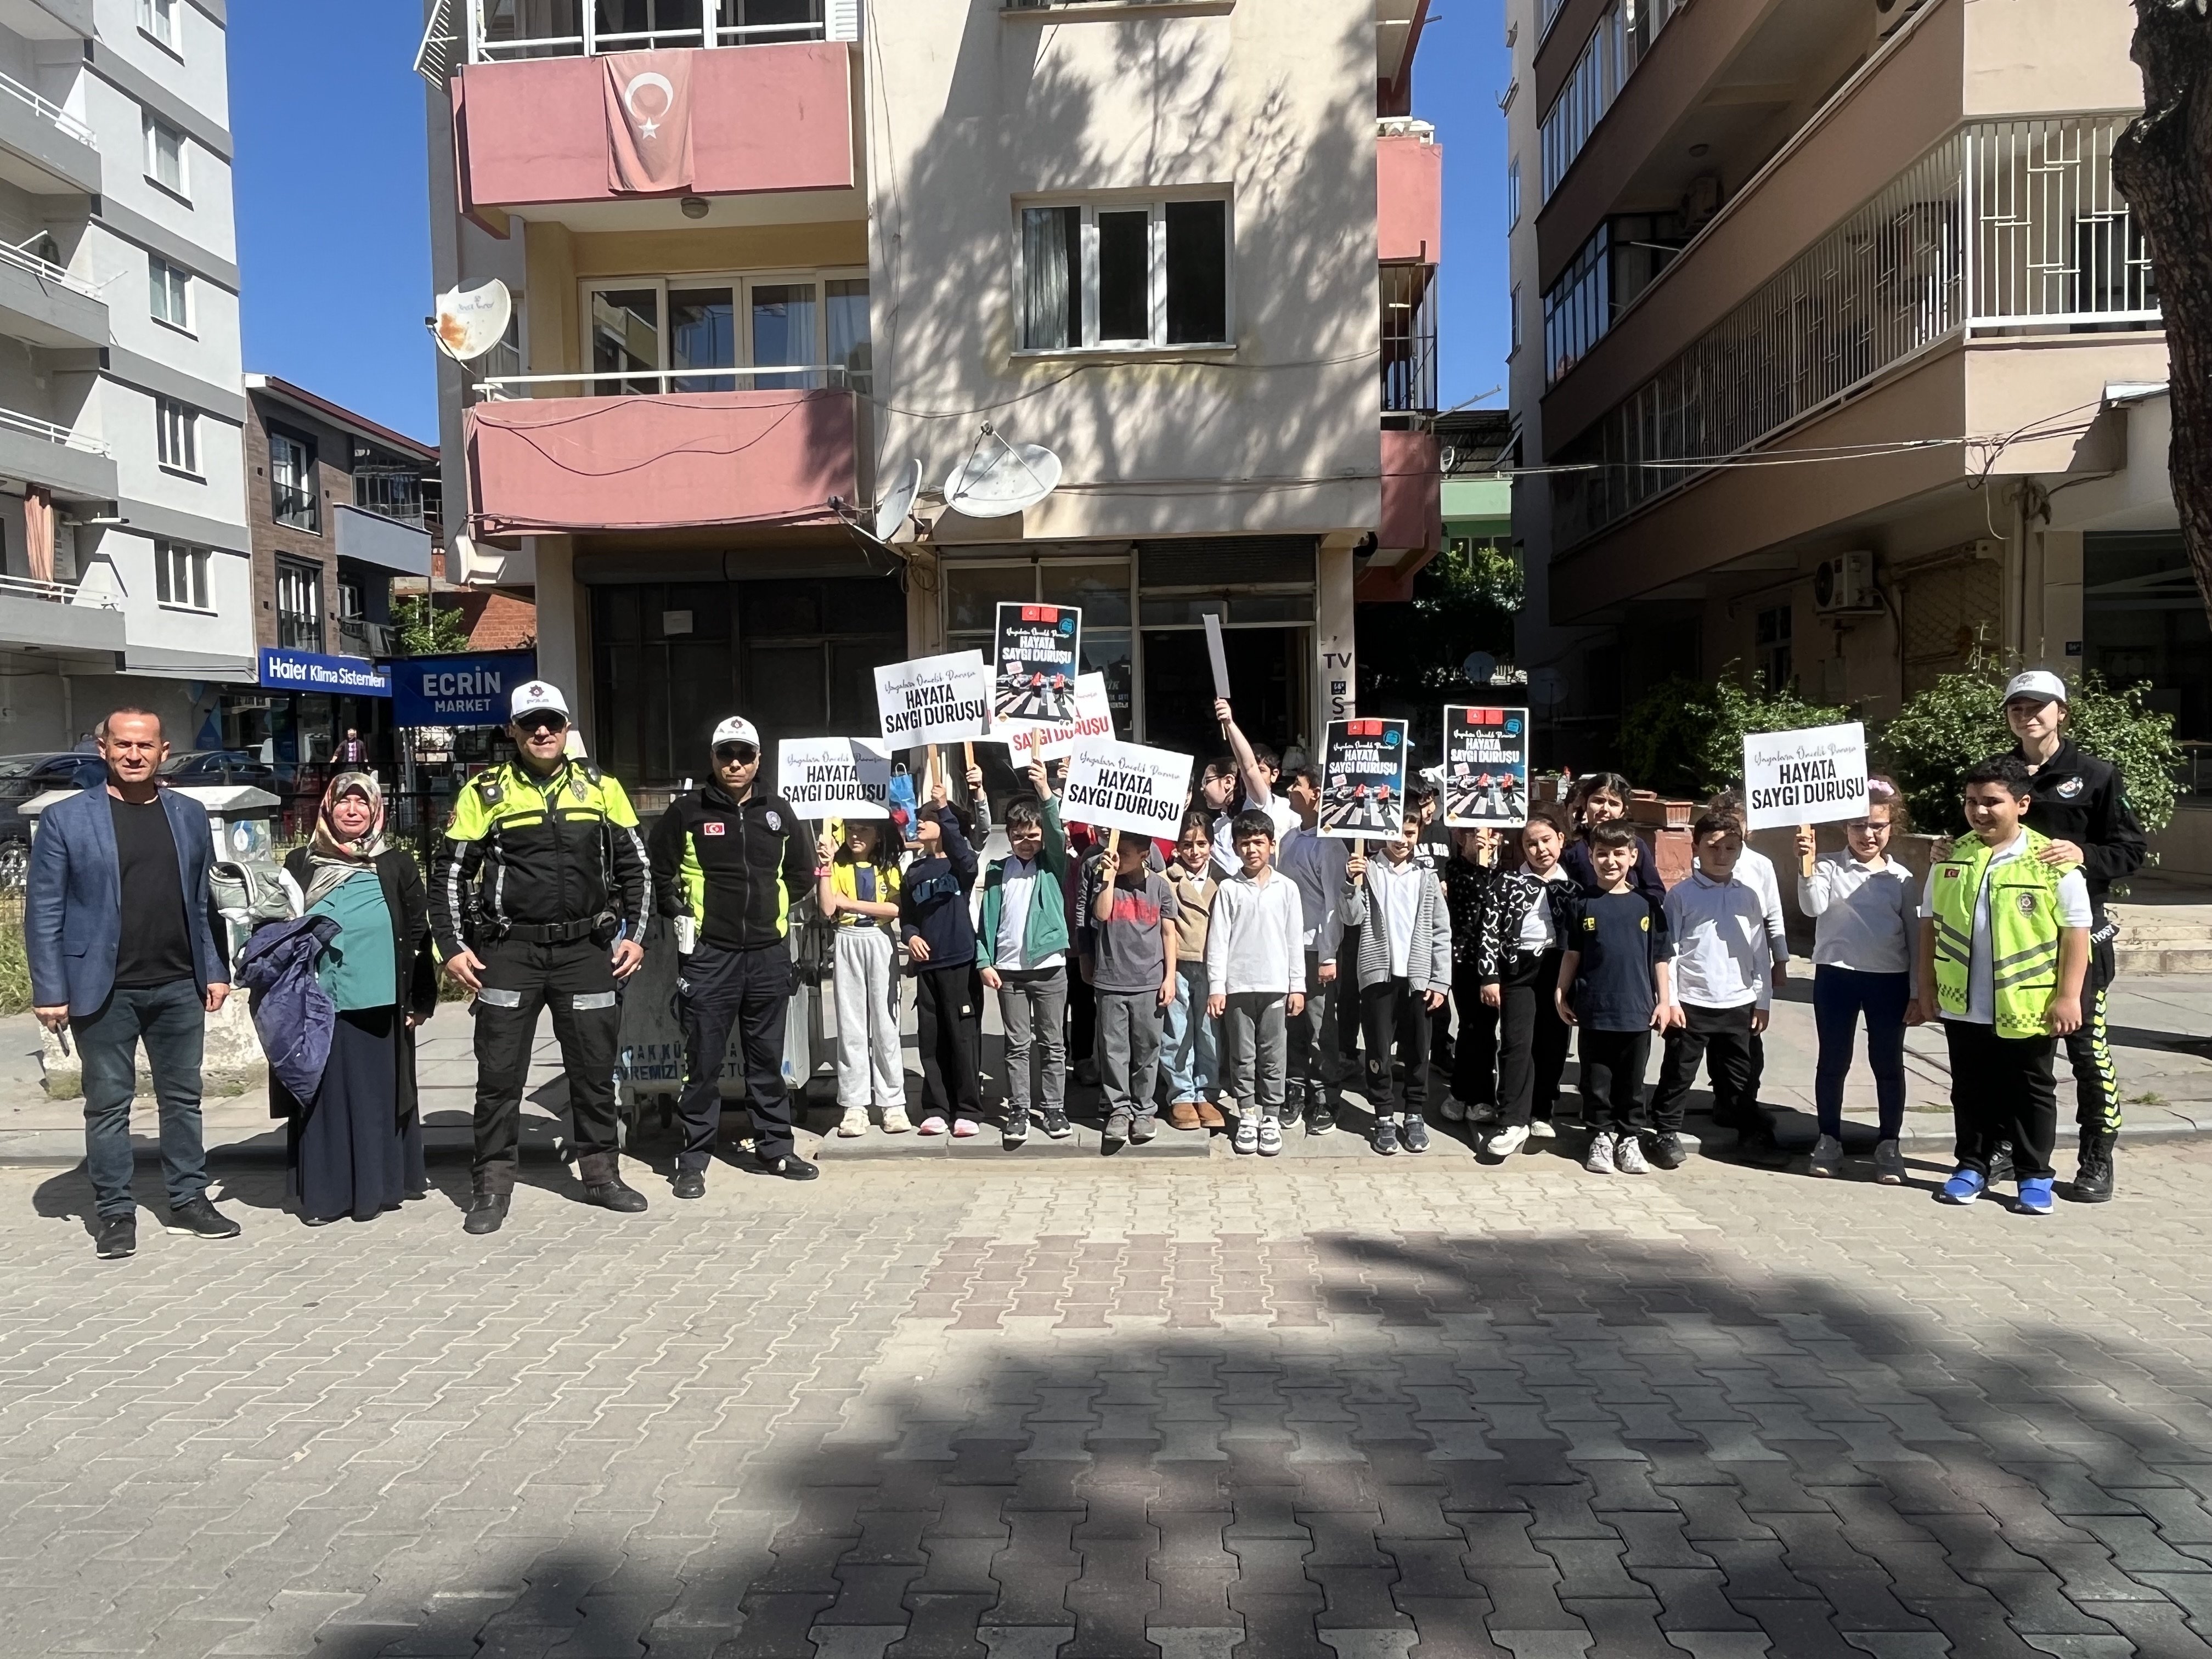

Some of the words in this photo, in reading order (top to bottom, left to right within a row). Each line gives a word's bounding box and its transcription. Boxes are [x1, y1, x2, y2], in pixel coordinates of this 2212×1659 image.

[1020, 636, 1056, 650] HAYATA
[1002, 647, 1032, 661] SAYGI
[1322, 652, 1352, 668] TV
[269, 657, 307, 680] Haier
[310, 665, 338, 683] Klima
[423, 666, 501, 696] ECRİN
[906, 684, 955, 709] HAYATA
[435, 699, 491, 712] MARKET
[885, 709, 922, 733] SAYGI
[924, 699, 985, 726] DURUŞU
[1466, 738, 1500, 751] HAYATA
[1345, 749, 1380, 762] HAYATA
[1451, 749, 1477, 763] SAYGI
[807, 765, 859, 782] HAYATA
[1329, 761, 1355, 774] SAYGI
[1779, 759, 1836, 784] HAYATA
[1098, 769, 1152, 795] HAYATA
[783, 785, 821, 803] SAYGI
[1752, 785, 1799, 809] SAYGI
[1803, 777, 1864, 804] DURUŞU
[1069, 783, 1113, 809] SAYGI
[1114, 792, 1179, 821] DURUŞU
